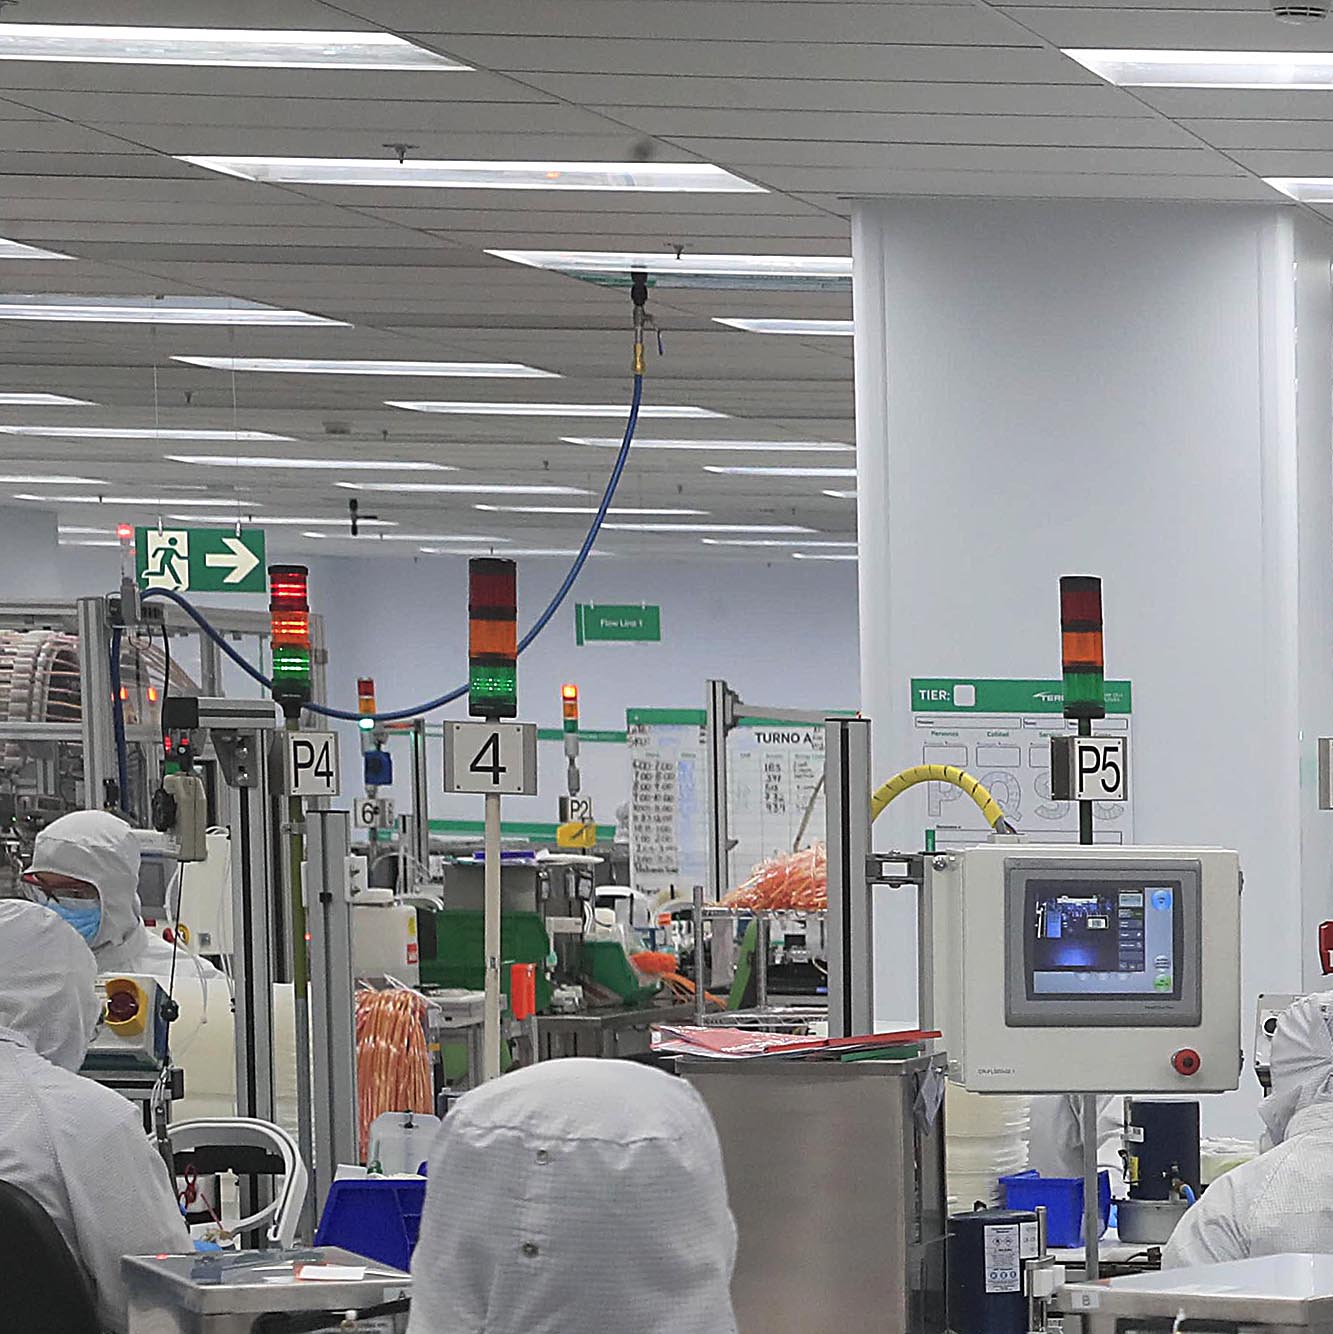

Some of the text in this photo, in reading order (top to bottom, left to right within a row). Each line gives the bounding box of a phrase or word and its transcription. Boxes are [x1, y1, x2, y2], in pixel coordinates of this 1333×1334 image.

[919, 689, 950, 701] TIER:
[755, 732, 812, 744] TURNO A
[292, 740, 334, 788] P4
[469, 732, 507, 785] 4
[1078, 745, 1120, 793] P5
[361, 803, 375, 824] 6
[570, 799, 589, 820] P2
[1082, 1295, 1090, 1306] B
